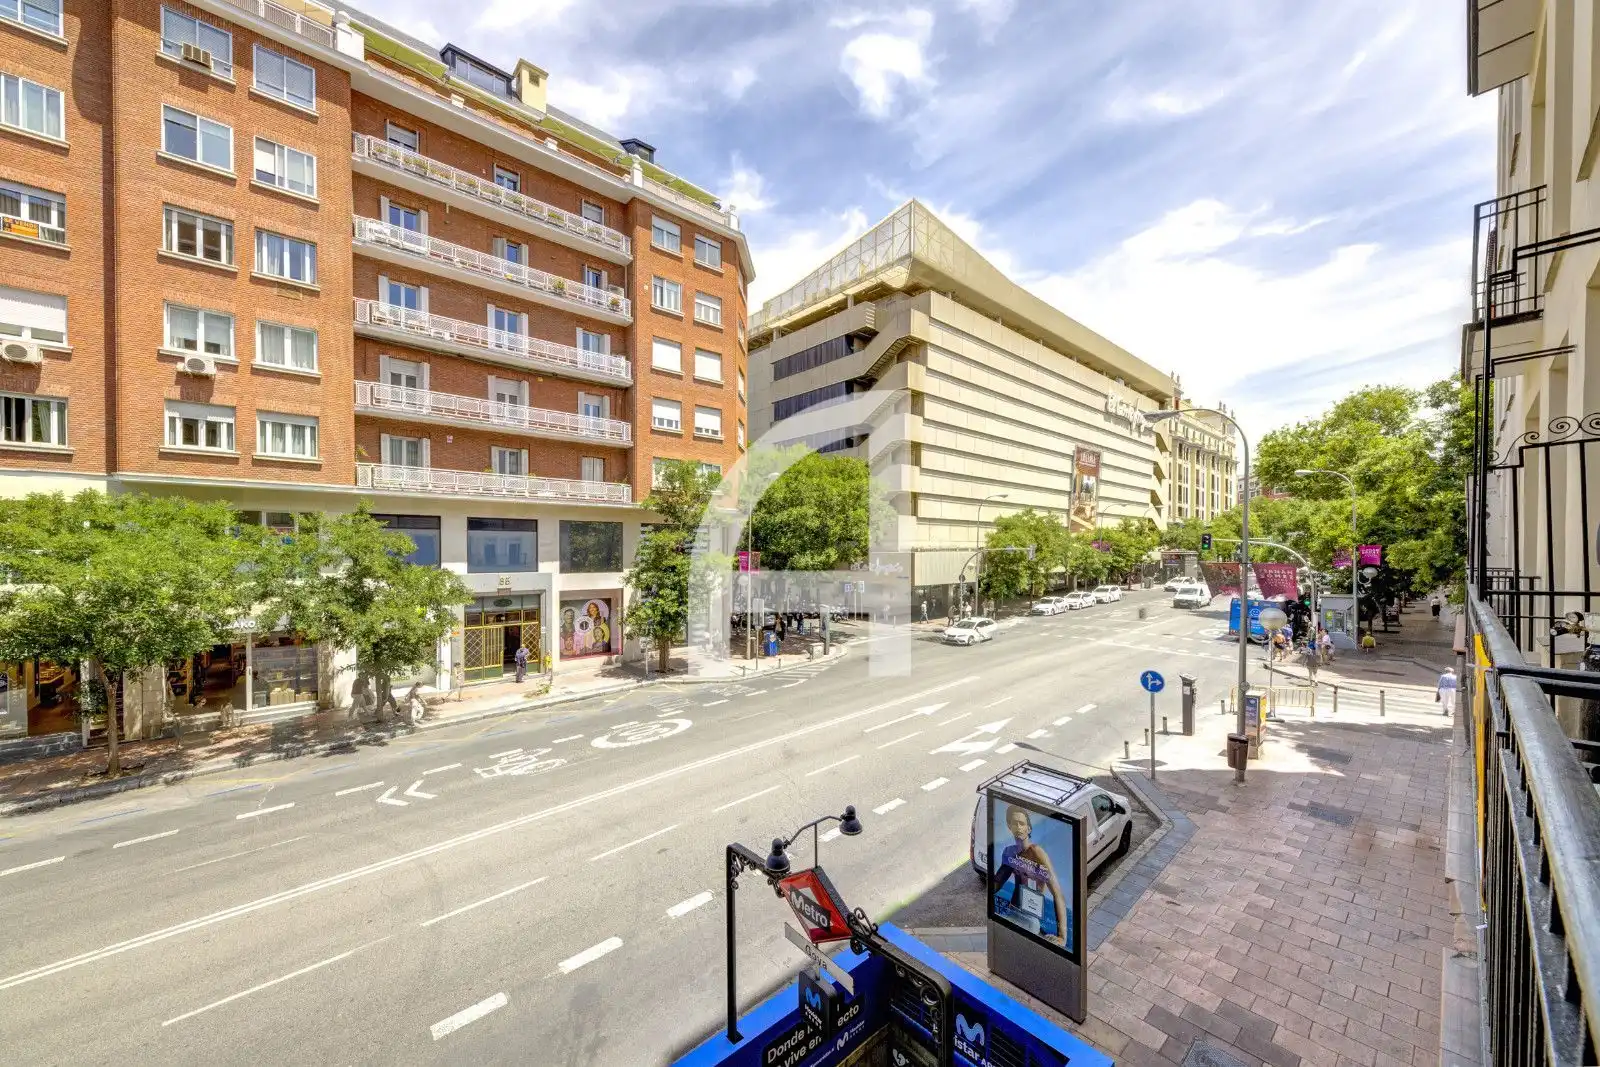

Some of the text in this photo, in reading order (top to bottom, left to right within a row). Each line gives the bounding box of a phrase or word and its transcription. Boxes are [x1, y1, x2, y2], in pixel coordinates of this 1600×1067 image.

[790, 890, 828, 928] Metro
[805, 944, 828, 970] Goya
[767, 1029, 805, 1064] Donde
[784, 1045, 807, 1067] vive
[837, 1004, 859, 1027] ecto
